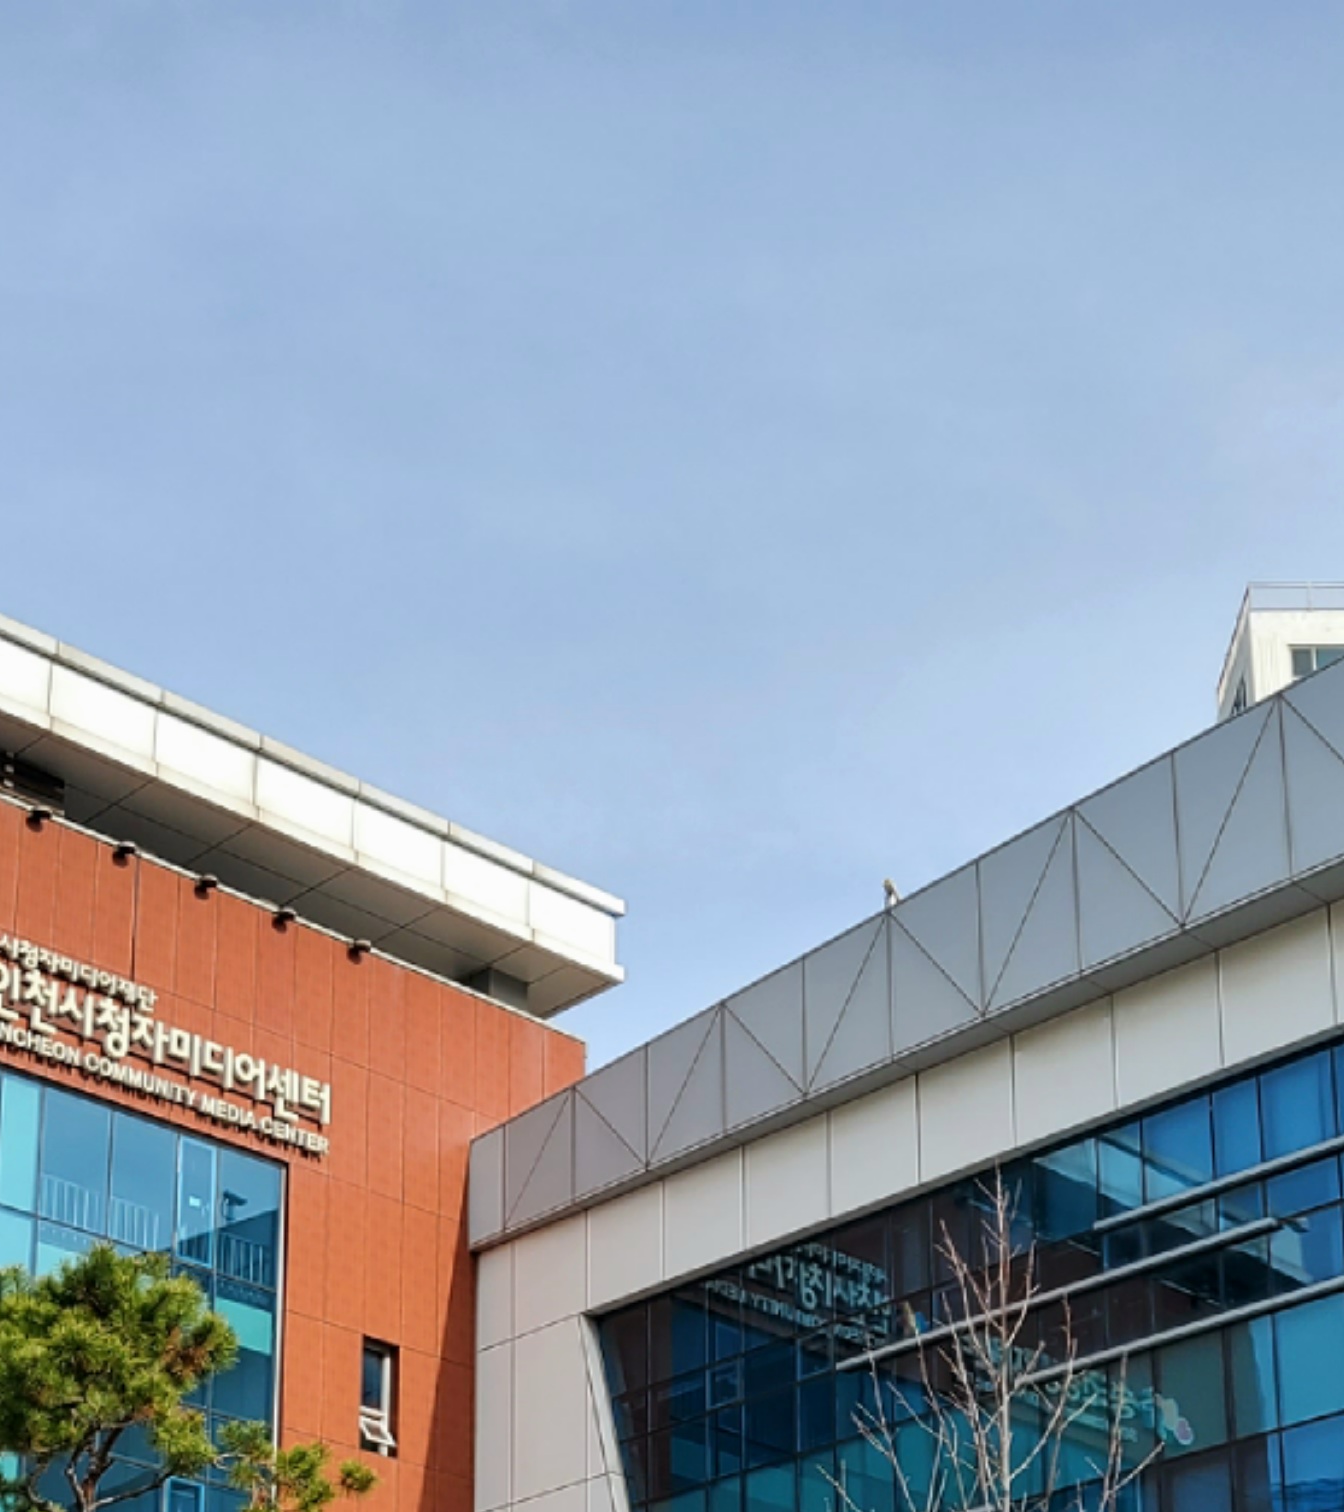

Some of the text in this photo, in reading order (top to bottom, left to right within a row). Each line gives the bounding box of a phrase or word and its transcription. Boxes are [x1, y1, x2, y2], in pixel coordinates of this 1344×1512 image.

[84, 1053, 197, 1105] COMMUNITY
[201, 1095, 257, 1129] MEDIA
[260, 1116, 329, 1154] CENTER
